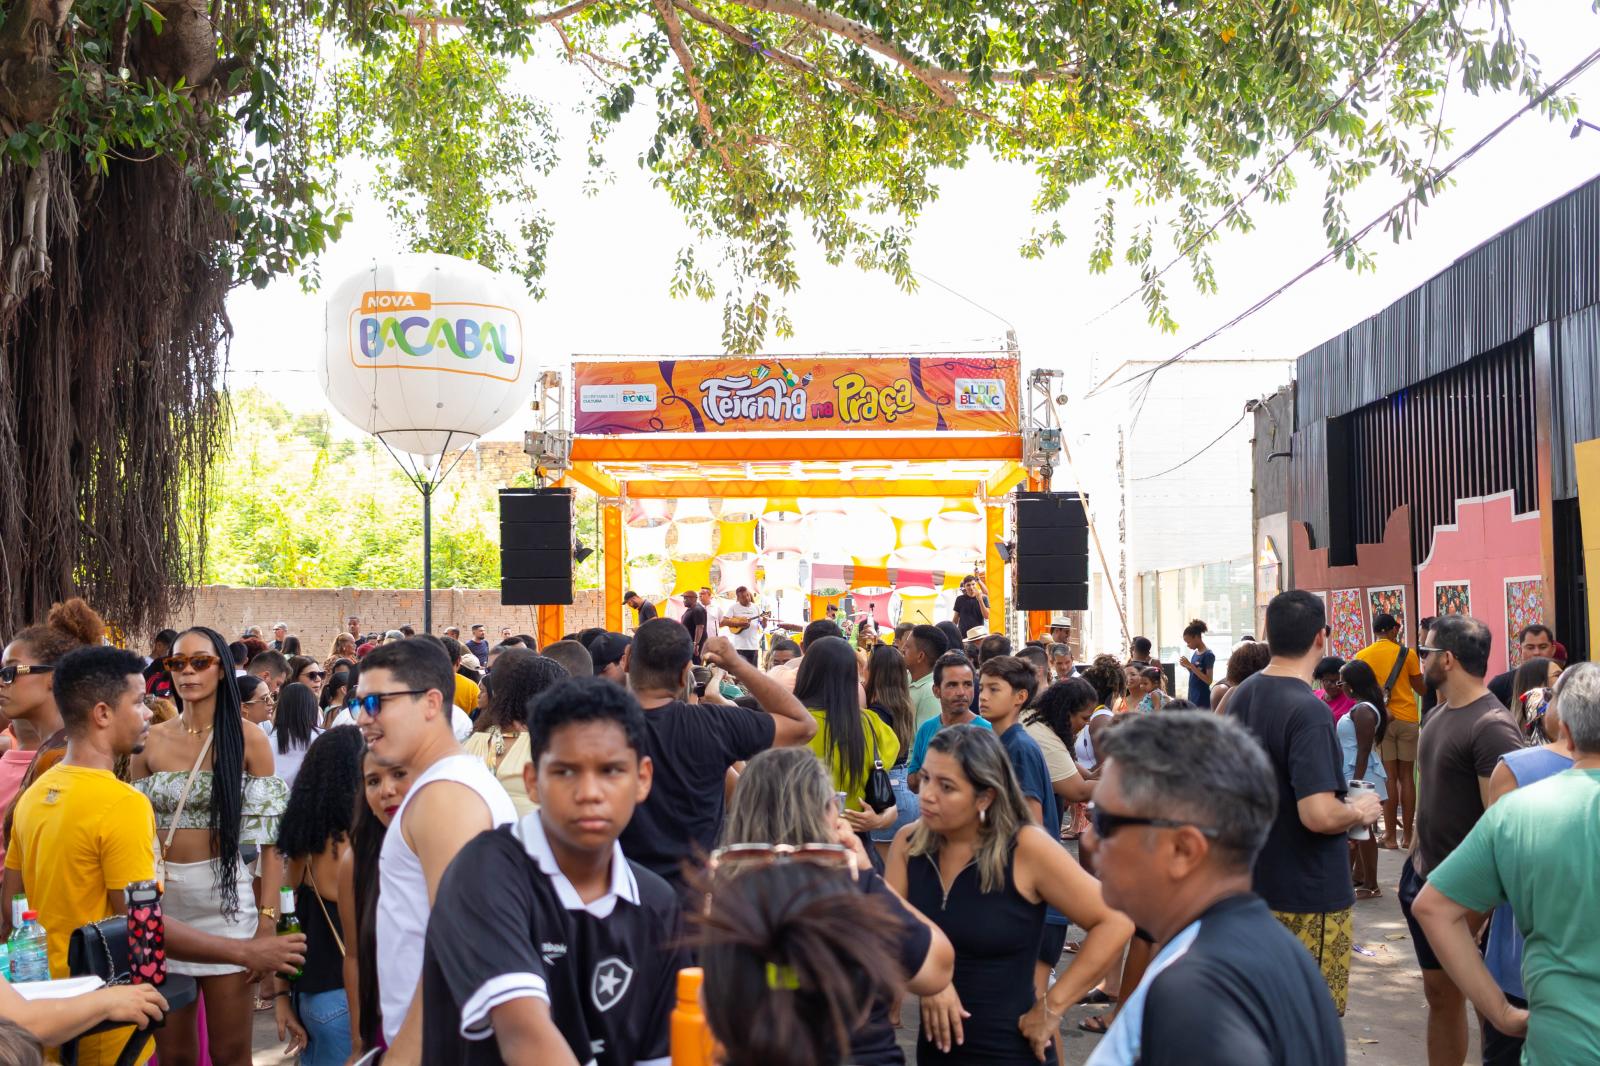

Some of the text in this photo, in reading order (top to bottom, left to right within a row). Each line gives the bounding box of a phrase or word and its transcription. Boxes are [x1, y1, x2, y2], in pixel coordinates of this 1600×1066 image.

[367, 295, 416, 308] NOVA
[360, 317, 515, 364] BACABAL
[962, 385, 997, 395] ALDIR
[699, 372, 915, 425] Feirinha na Praça
[961, 395, 1000, 405] BLANC
